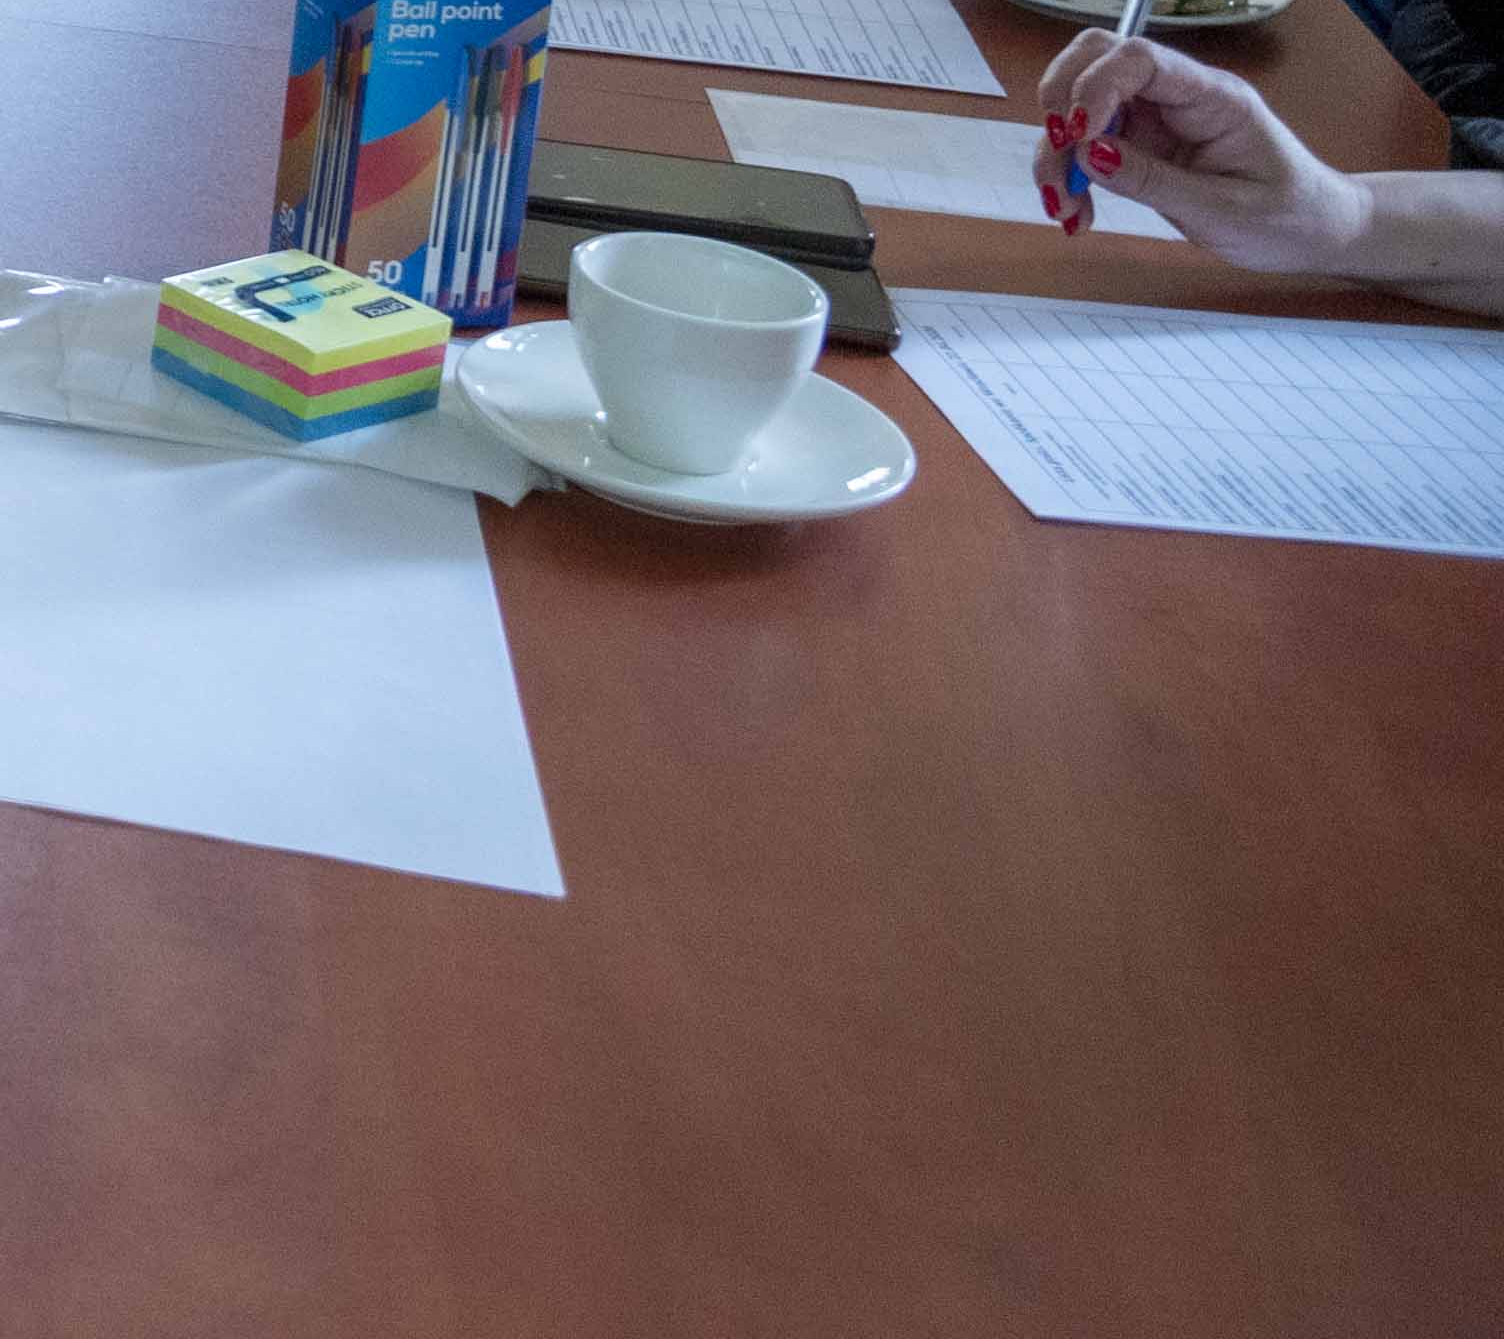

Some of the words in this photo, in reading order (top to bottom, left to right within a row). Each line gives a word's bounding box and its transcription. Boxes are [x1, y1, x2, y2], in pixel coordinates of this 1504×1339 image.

[440, 0, 505, 25] point
[387, 23, 437, 43] pen
[368, 259, 404, 284] 50
